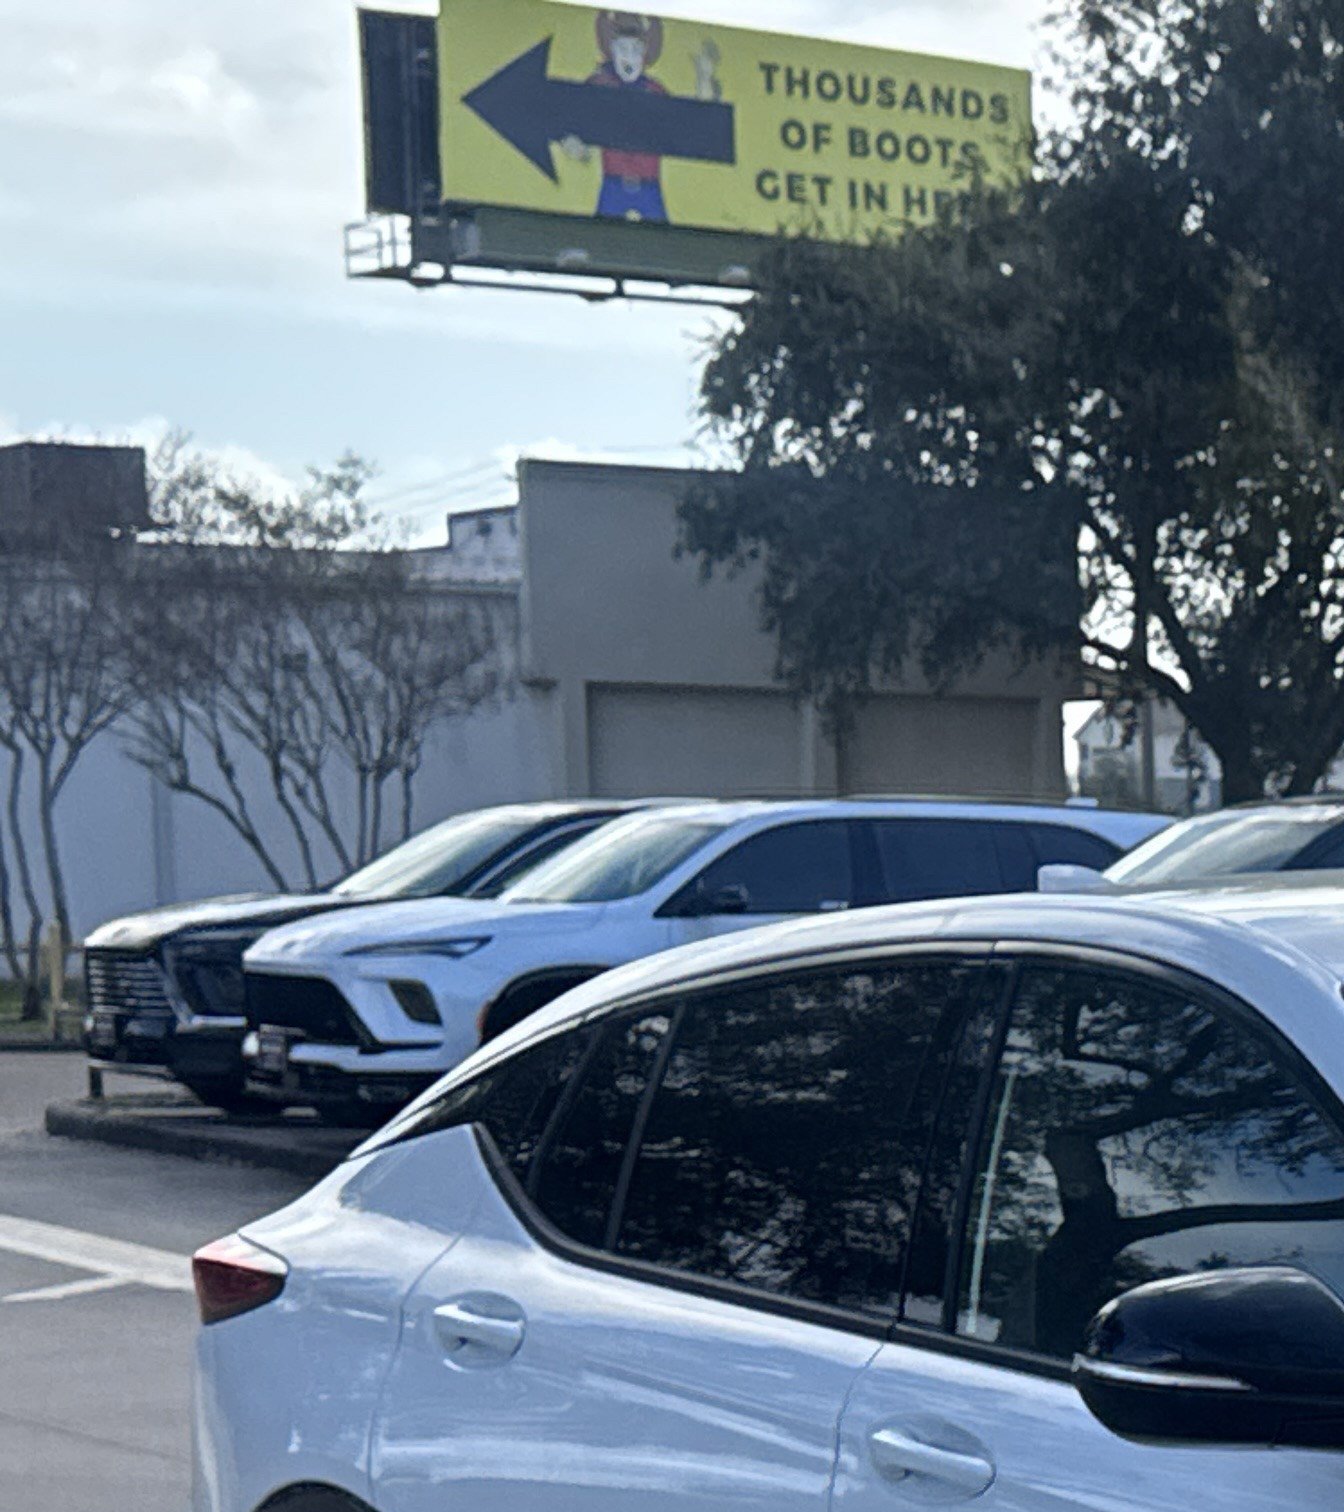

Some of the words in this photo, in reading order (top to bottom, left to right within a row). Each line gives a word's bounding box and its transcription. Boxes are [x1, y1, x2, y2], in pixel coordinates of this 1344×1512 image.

[758, 60, 1010, 125] THOUSANDS
[780, 118, 832, 154] OF
[847, 126, 983, 169] BOOTS
[755, 168, 832, 207] GET
[848, 179, 889, 213] IN
